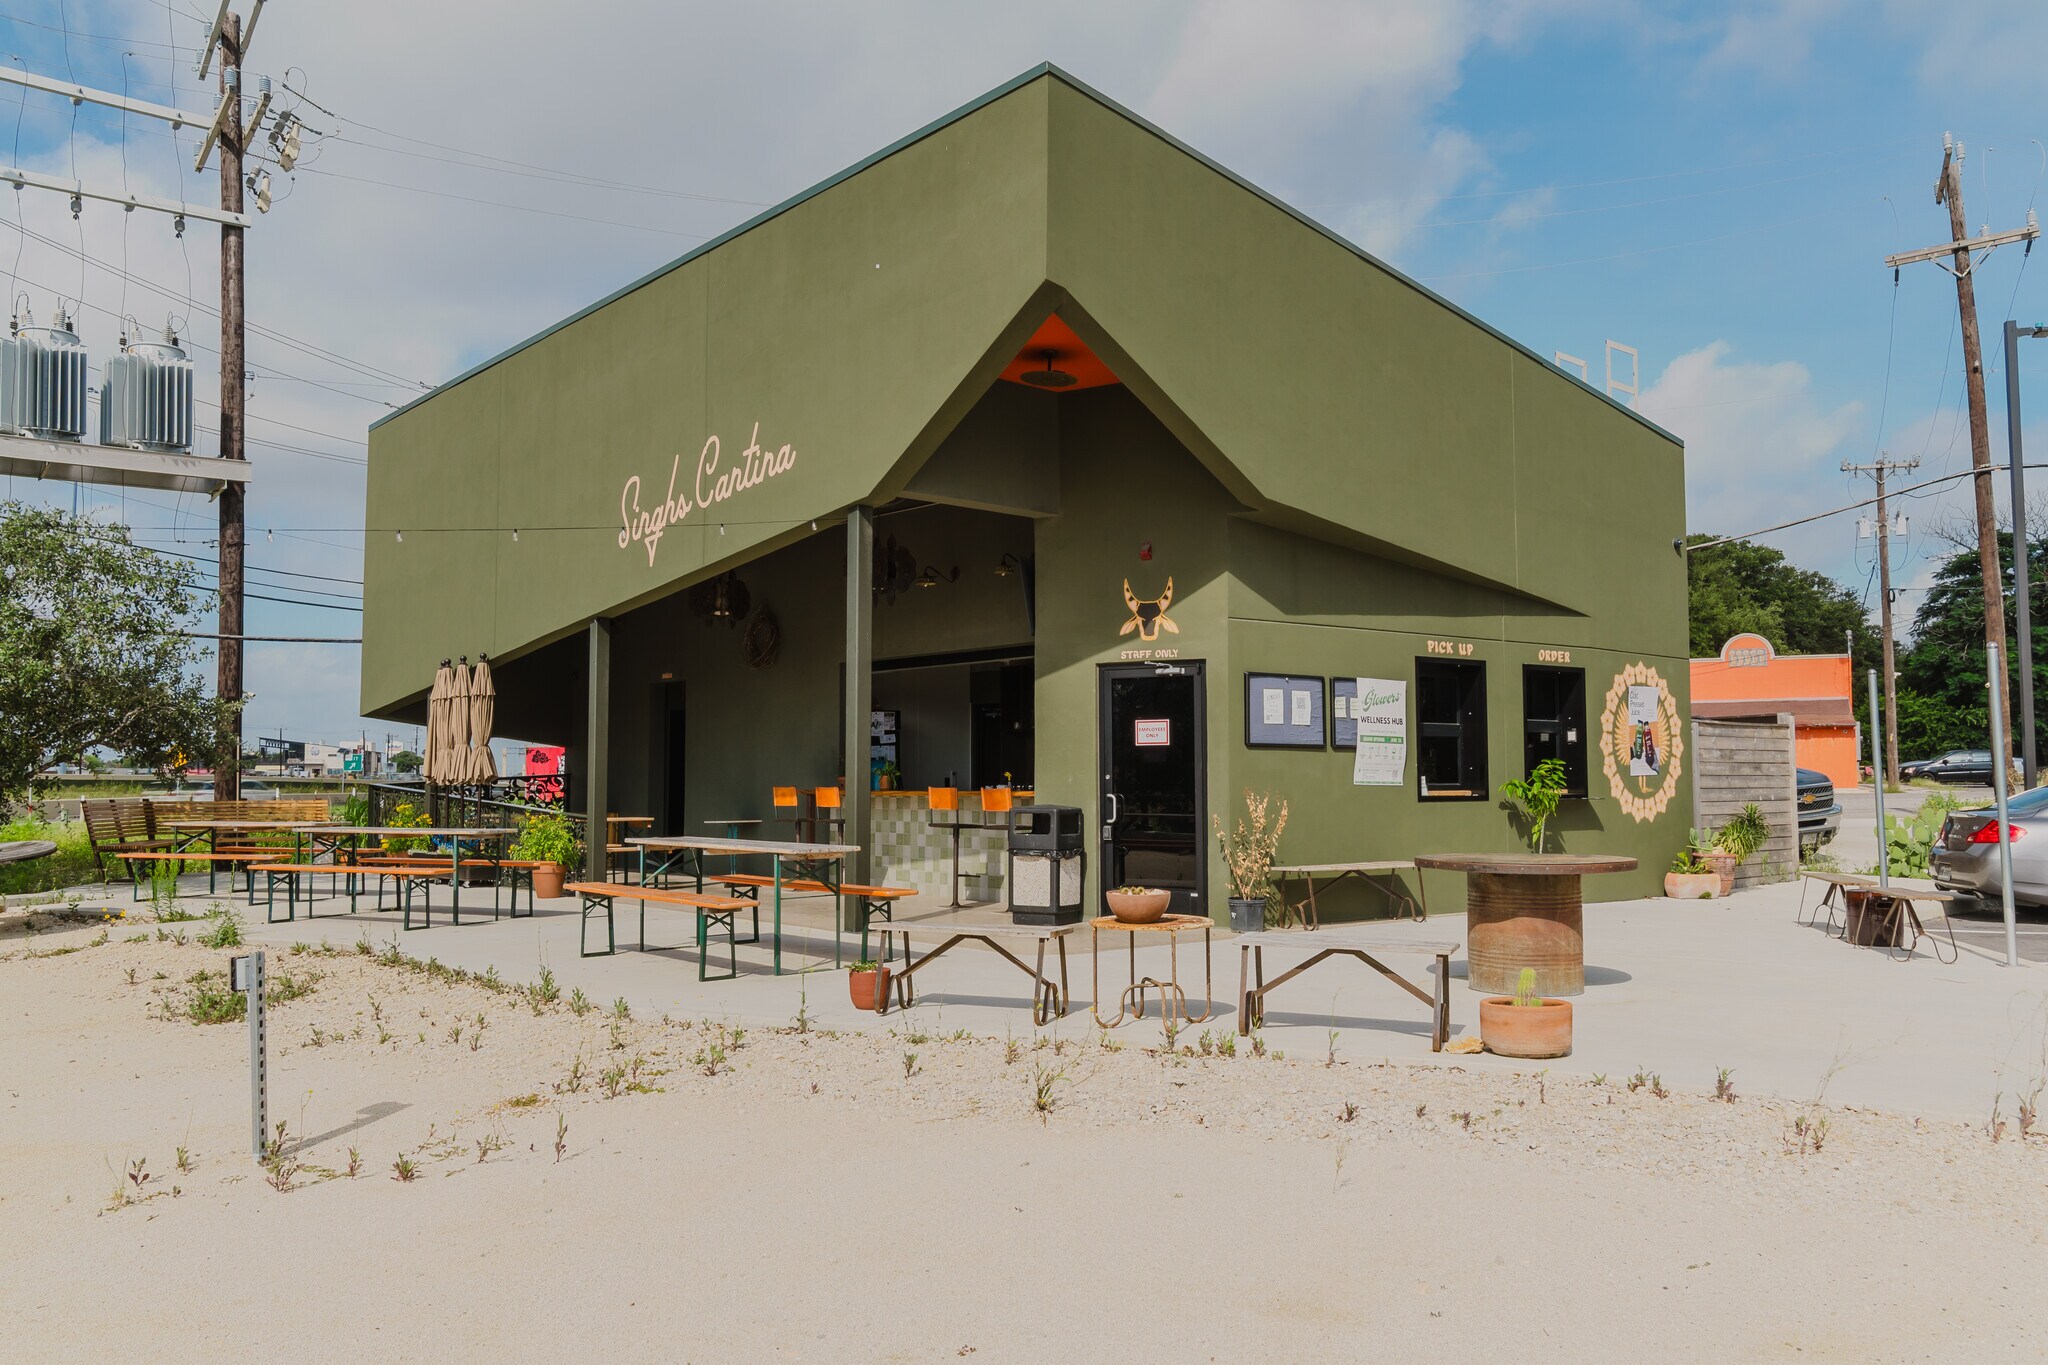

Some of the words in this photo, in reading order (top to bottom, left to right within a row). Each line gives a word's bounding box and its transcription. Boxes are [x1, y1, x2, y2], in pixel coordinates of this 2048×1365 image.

[618, 454, 692, 567] Singhs
[696, 422, 796, 509] Cantina
[1121, 650, 1152, 660] STAFF
[1155, 649, 1179, 658] ONLY
[1427, 640, 1454, 655] PICK
[1458, 643, 1474, 656] UP
[1538, 649, 1571, 663] ORDER
[1361, 716, 1391, 725] WELLNESS
[1391, 718, 1404, 726] HUB
